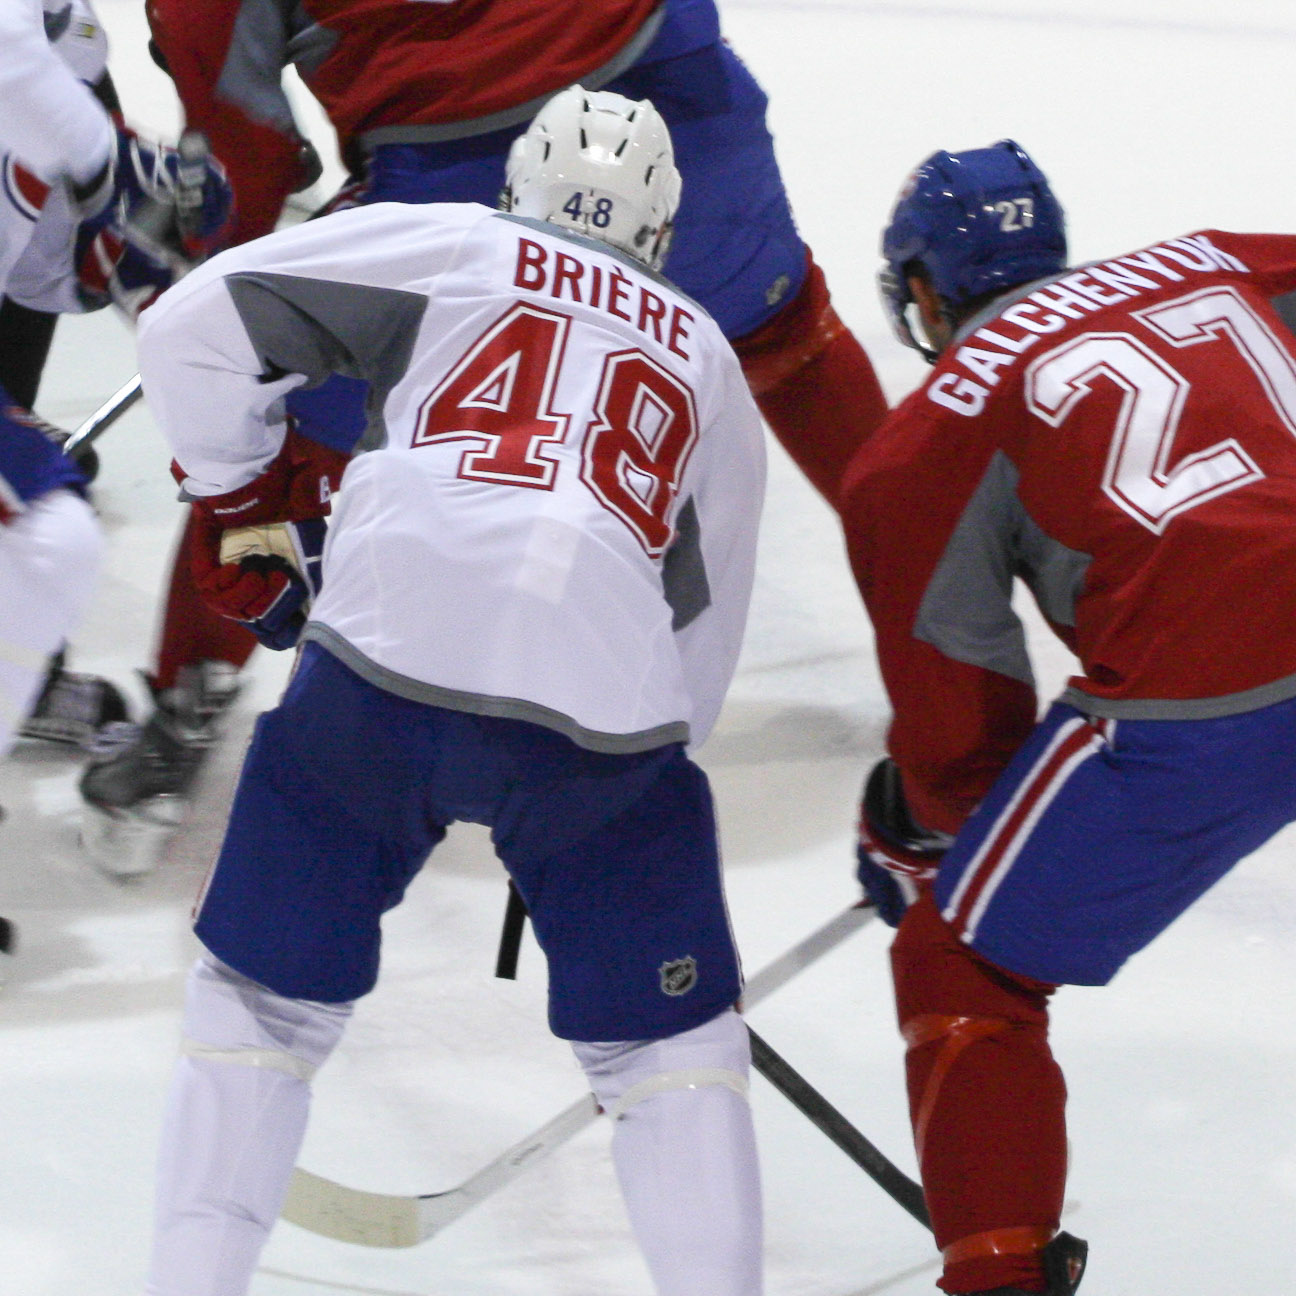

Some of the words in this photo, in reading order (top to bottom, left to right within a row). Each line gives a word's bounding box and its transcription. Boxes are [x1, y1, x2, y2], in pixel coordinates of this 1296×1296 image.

[562, 191, 613, 228] 48
[993, 197, 1035, 232] 27
[513, 237, 697, 363] BRIÈRE
[410, 299, 699, 559] 48
